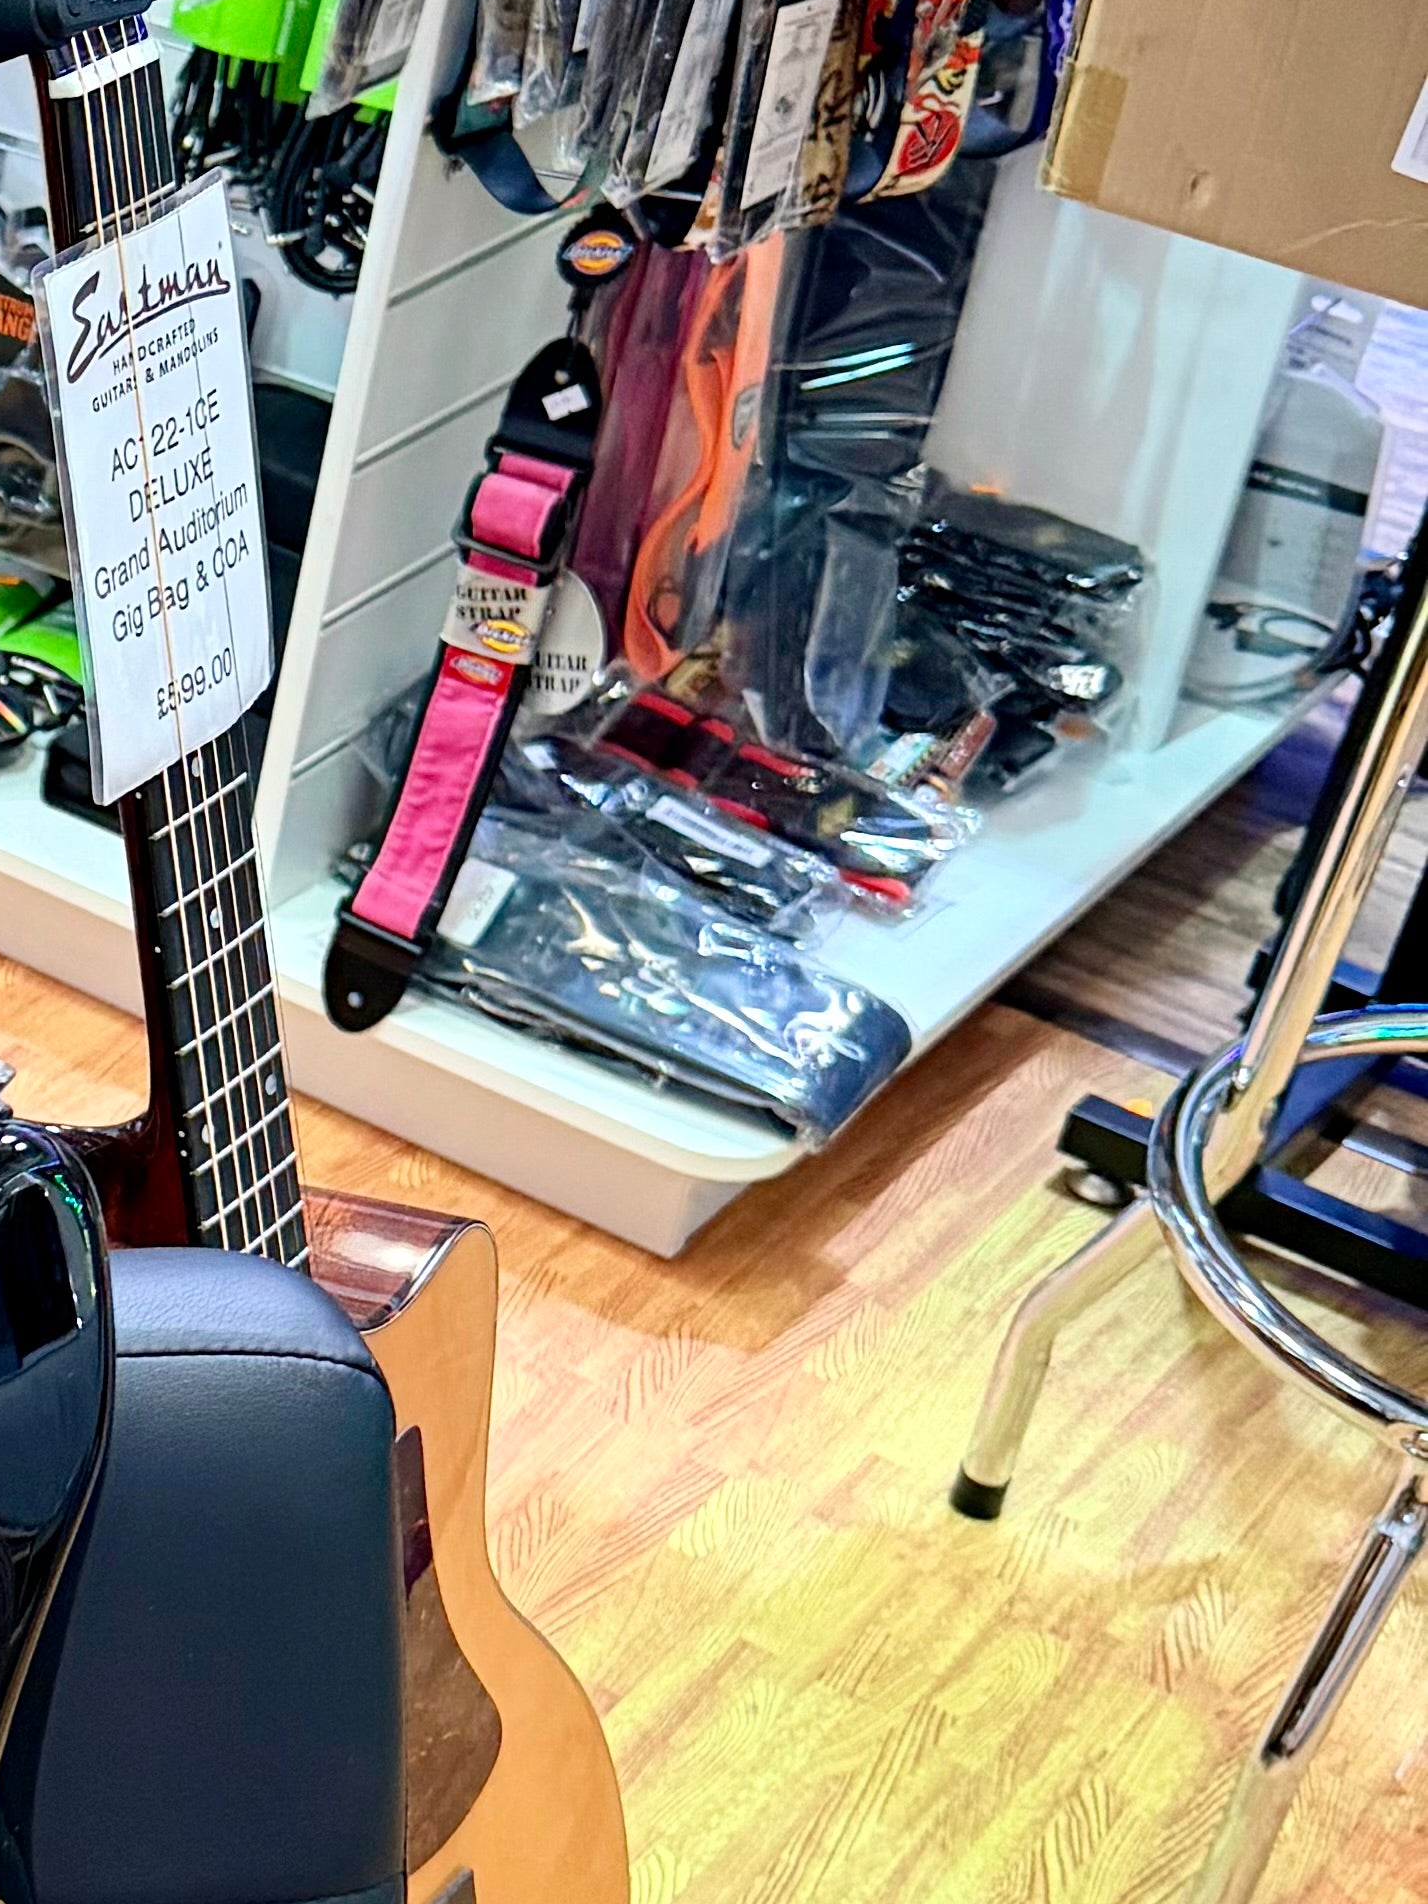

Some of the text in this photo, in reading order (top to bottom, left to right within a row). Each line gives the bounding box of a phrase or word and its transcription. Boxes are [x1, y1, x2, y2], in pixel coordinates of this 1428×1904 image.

[65, 255, 231, 385] Eastman
[144, 368, 155, 384] &
[158, 327, 219, 380] MANDOLINS
[110, 388, 220, 482] AC22-1CE
[93, 480, 249, 601] Grand Auditorium
[111, 594, 146, 644] Gig
[195, 560, 210, 590] &
[212, 531, 251, 582] COA
[456, 584, 527, 601] GUITAR
[456, 606, 520, 620] STRAP
